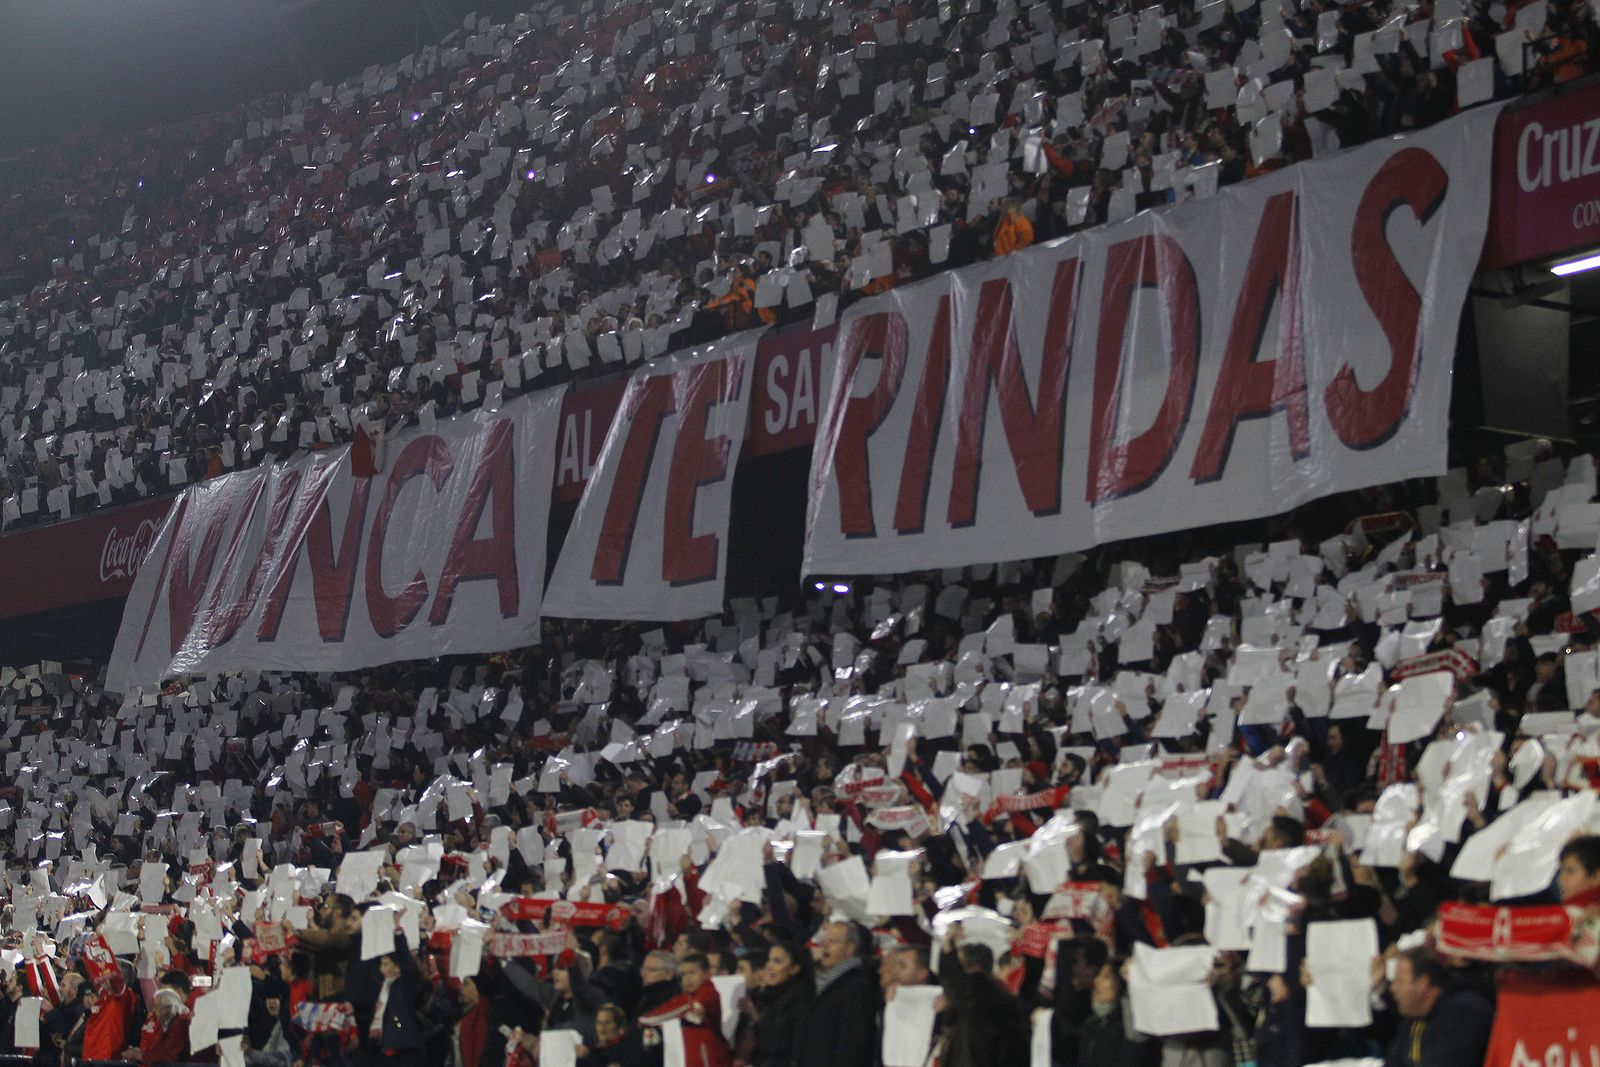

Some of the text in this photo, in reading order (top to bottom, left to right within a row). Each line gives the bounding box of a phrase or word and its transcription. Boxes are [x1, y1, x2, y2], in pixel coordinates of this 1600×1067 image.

[134, 147, 1447, 663] NUNCA TE RINDAS
